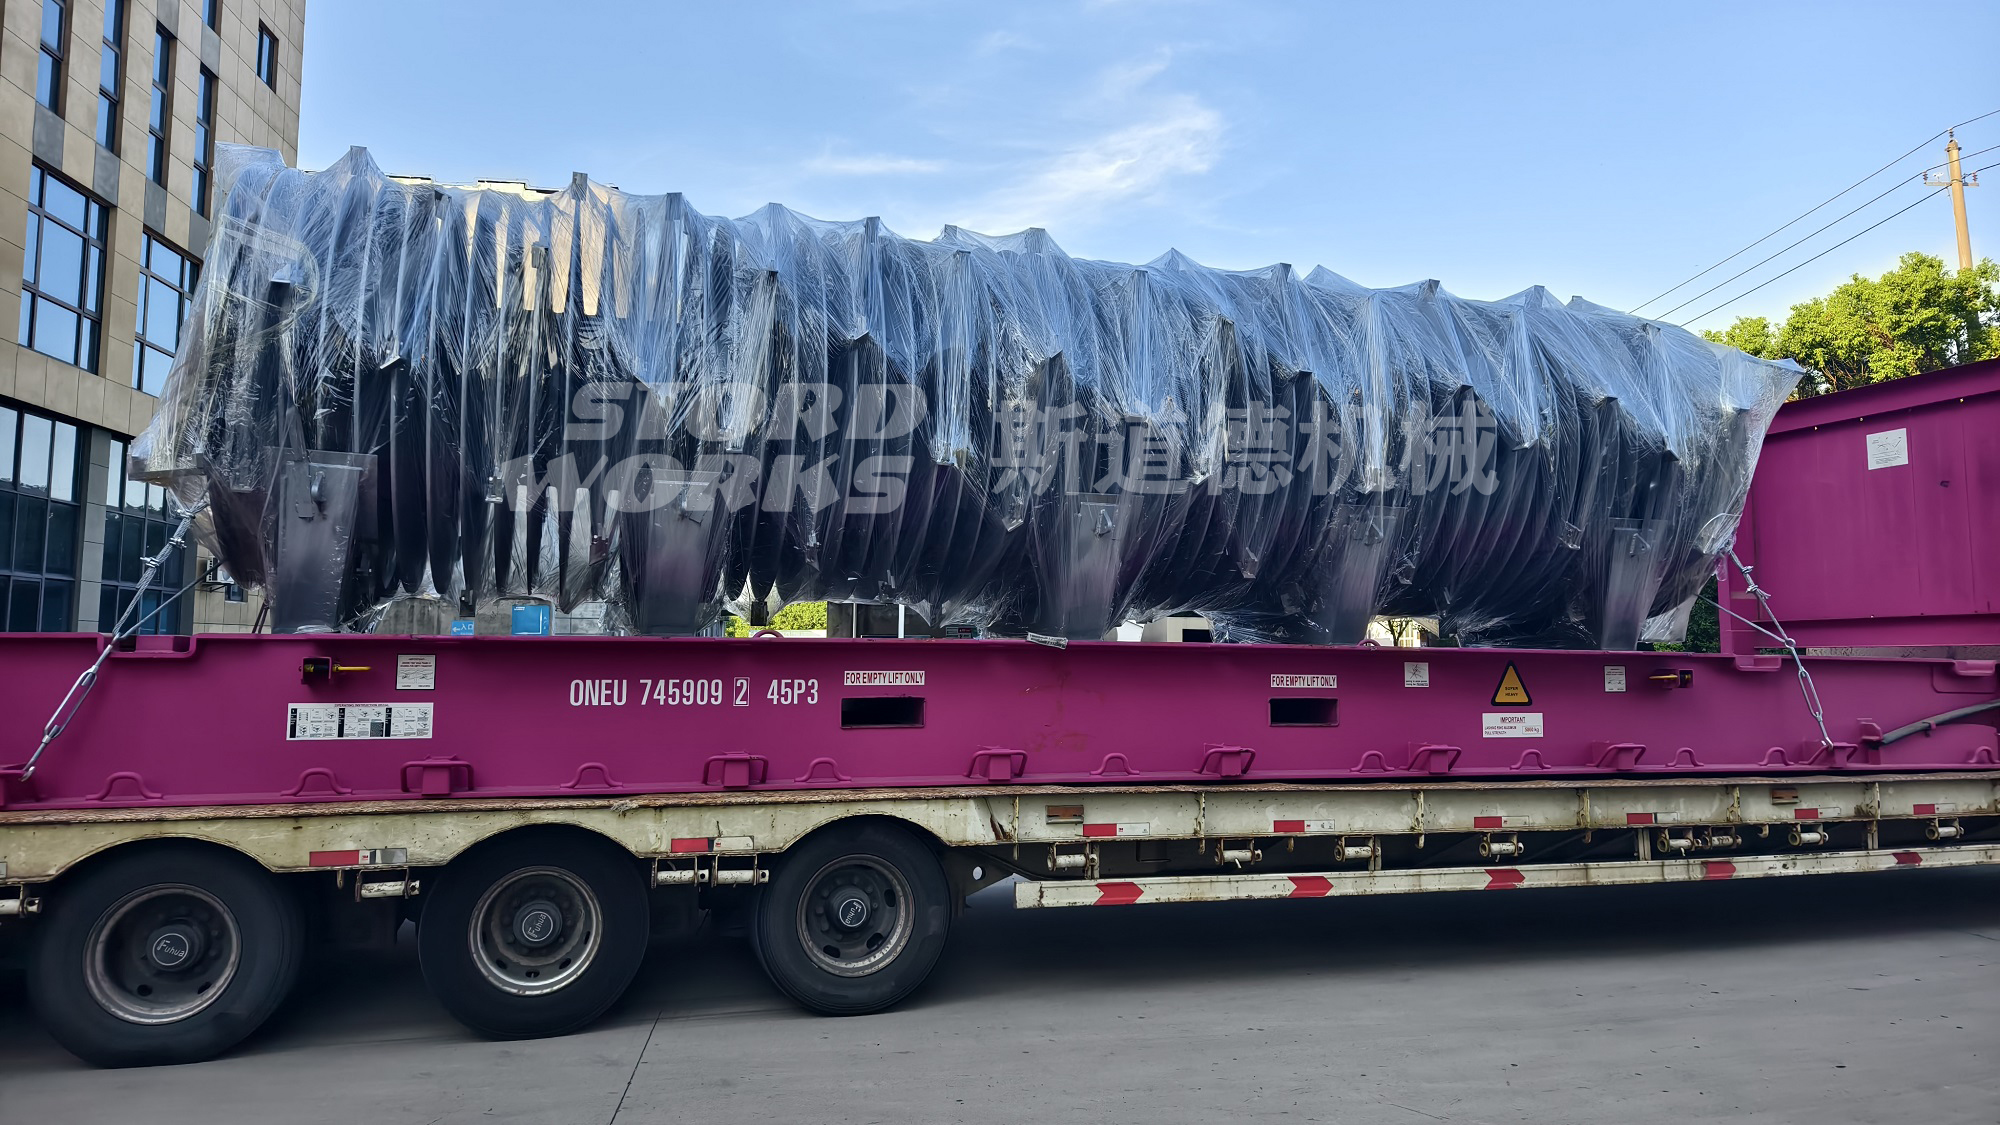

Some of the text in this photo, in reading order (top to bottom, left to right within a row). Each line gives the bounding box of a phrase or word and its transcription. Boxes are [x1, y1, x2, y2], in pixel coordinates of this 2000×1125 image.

[845, 672, 924, 684] FOR EMPTY LIFT ONLY
[1271, 675, 1336, 687] FOR EMPTY LIFT ONLY
[569, 679, 819, 706] ONEU 745909 2 45P3
[527, 913, 547, 938] Fuhua
[157, 940, 185, 957] Fuhua
